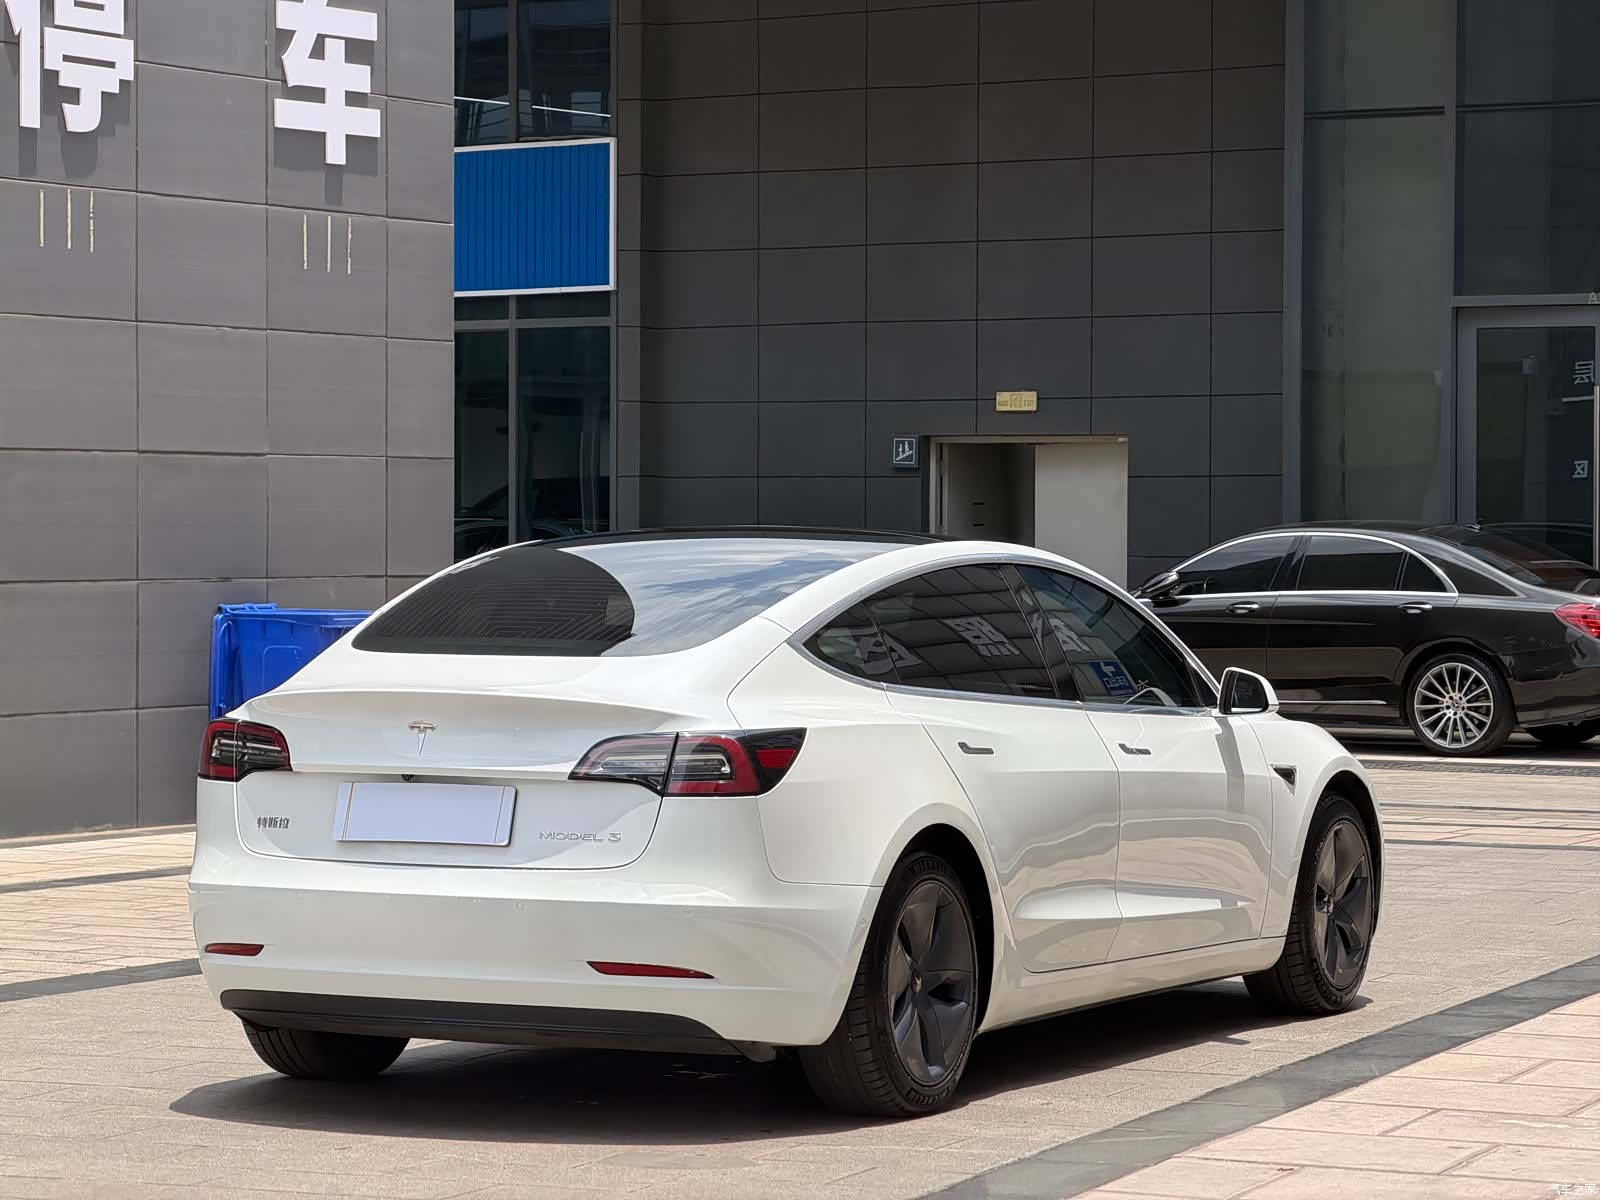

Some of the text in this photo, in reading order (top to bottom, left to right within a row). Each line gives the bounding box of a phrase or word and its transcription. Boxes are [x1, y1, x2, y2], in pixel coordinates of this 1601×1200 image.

[256, 816, 291, 829] 特斯拉
[539, 830, 604, 843] MODEL
